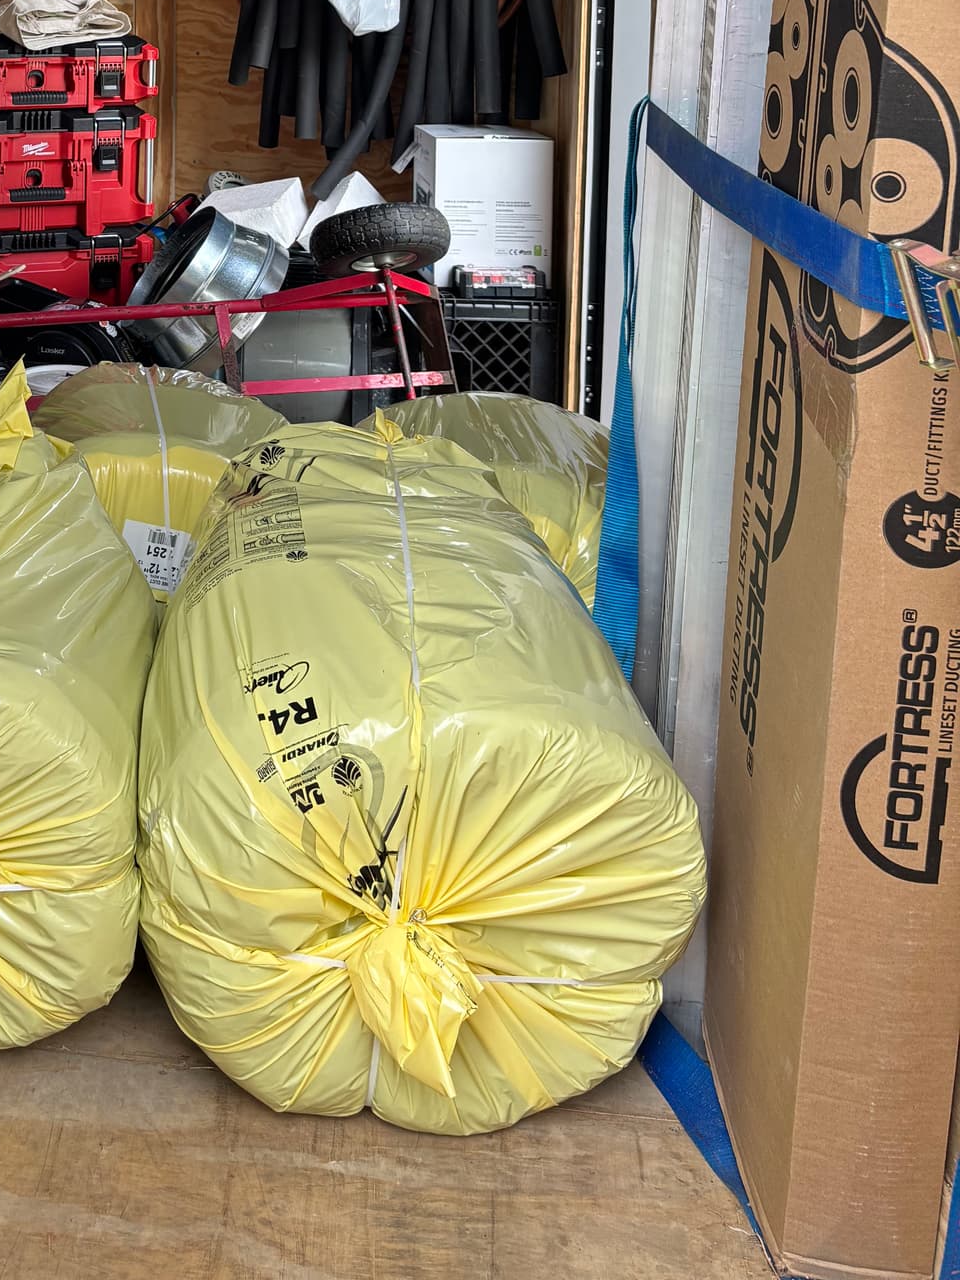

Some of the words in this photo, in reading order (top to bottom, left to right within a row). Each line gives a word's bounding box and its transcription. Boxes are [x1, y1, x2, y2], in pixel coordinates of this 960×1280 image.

[923, 387, 948, 496] DUCT/FITTINGS
[146, 545, 167, 558] 251
[736, 492, 752, 595] LINESET
[728, 597, 744, 706] DUCTING
[944, 629, 960, 693] DUCTING
[258, 696, 318, 737] R4.
[937, 696, 957, 753] LINESET
[280, 737, 327, 762] HARDI
